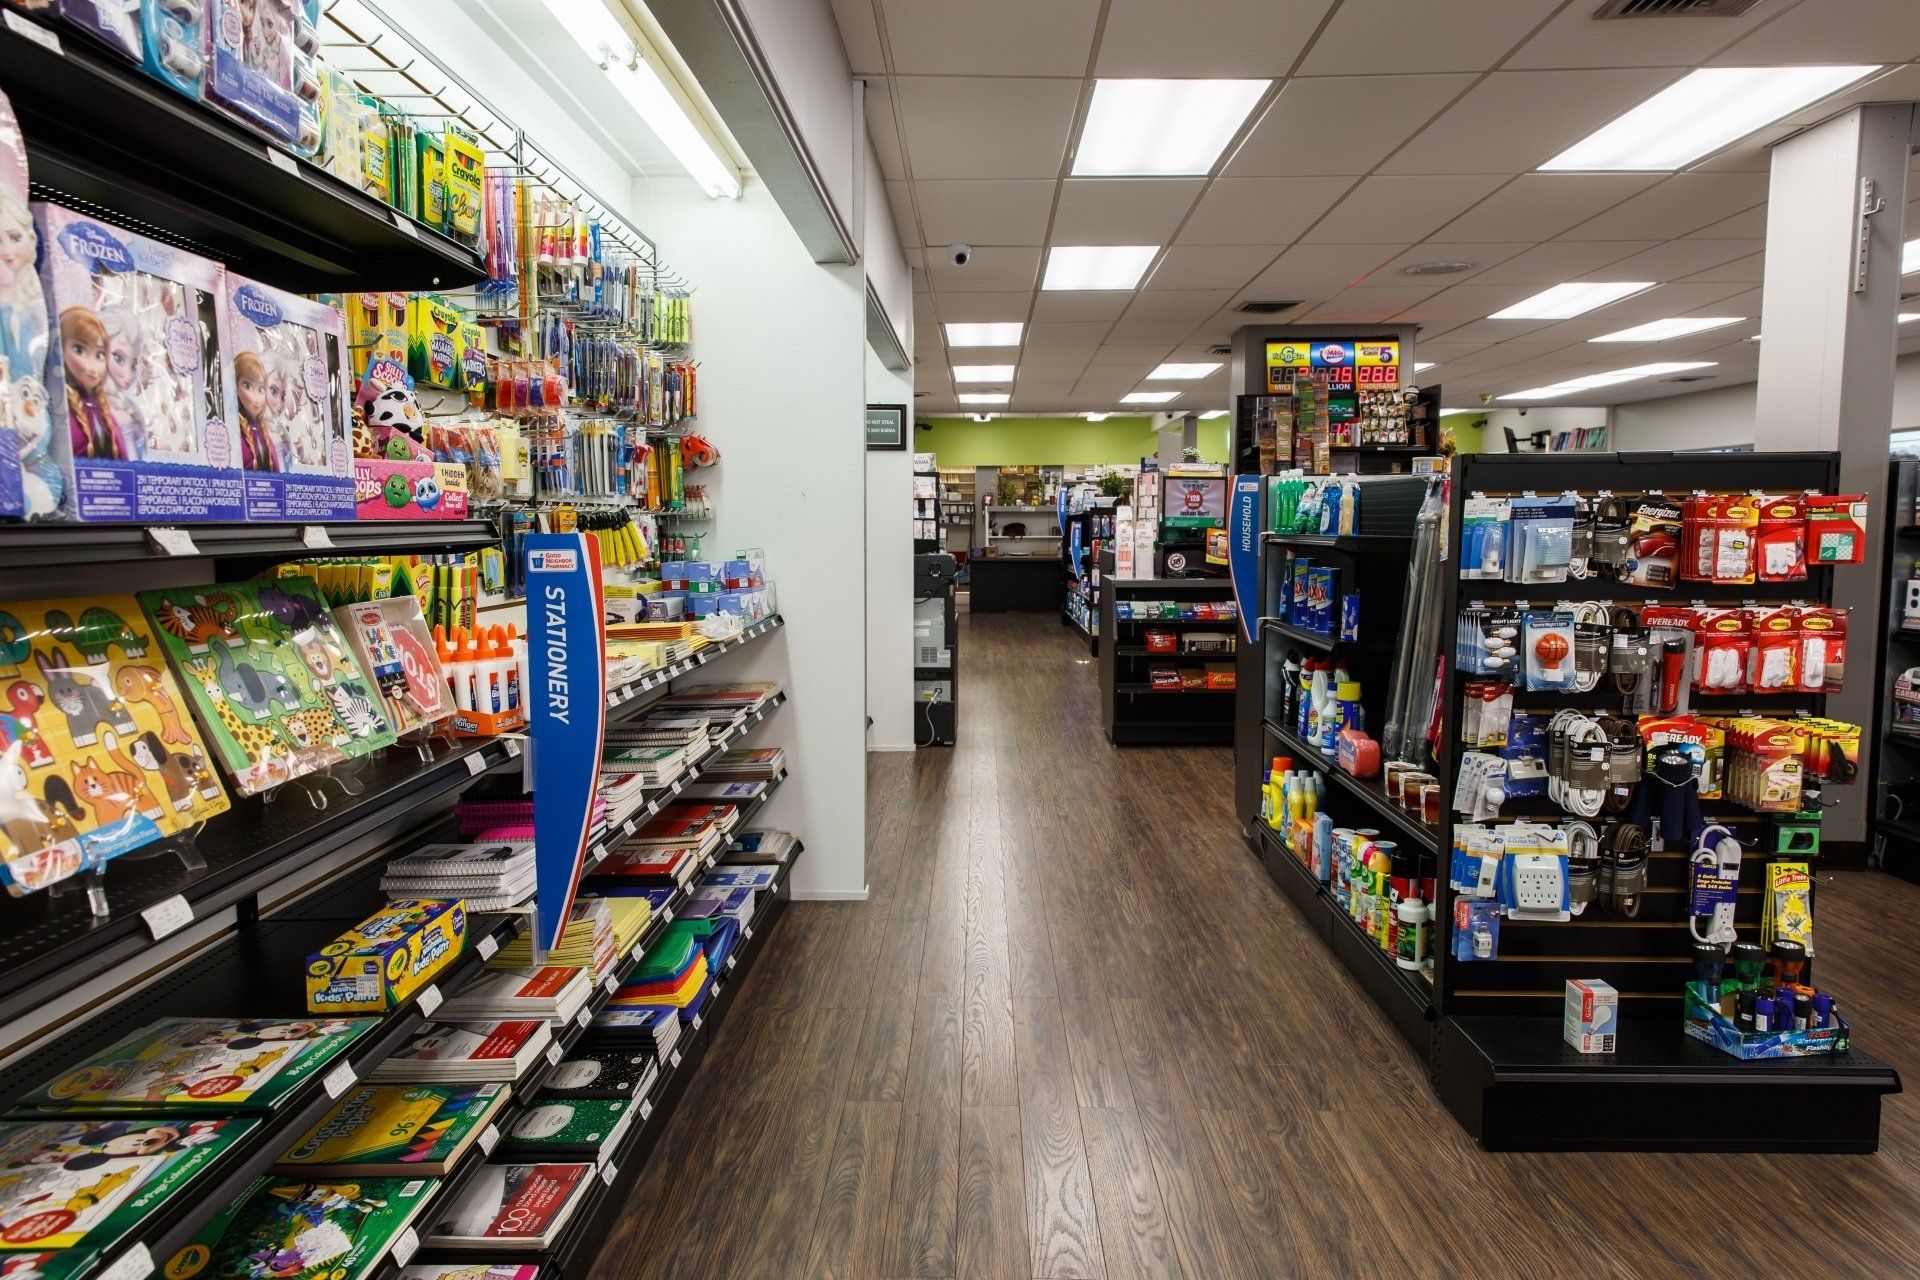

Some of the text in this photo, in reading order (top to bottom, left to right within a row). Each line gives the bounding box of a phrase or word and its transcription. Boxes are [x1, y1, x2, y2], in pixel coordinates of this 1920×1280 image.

[451, 163, 481, 186] Crayola
[70, 237, 126, 264] FROZEN
[241, 294, 278, 317] FROZEN
[433, 306, 457, 324] Crayola
[1380, 347, 1393, 363] 5
[462, 359, 485, 377] MARKERS
[148, 475, 181, 486] TEMPORARY
[212, 478, 226, 488] SPRAY
[142, 485, 180, 495] APPLICATION
[180, 487, 203, 496] SPONGE
[444, 492, 463, 502] Collect
[1242, 496, 1252, 552] HOUSEHOLD
[375, 587, 390, 599] Chalk
[1647, 618, 1690, 627] EVEREADY
[1771, 621, 1789, 629] Command
[1803, 620, 1829, 628] Command
[545, 585, 570, 726] STATIONERY
[1774, 866, 1782, 876] 3
[1775, 877, 1789, 888] Little
[429, 940, 450, 964] Paint
[289, 1087, 380, 1159] Construction
[390, 1120, 416, 1136] 96
[497, 1208, 530, 1236] 100
[520, 1213, 537, 1232] sheets
